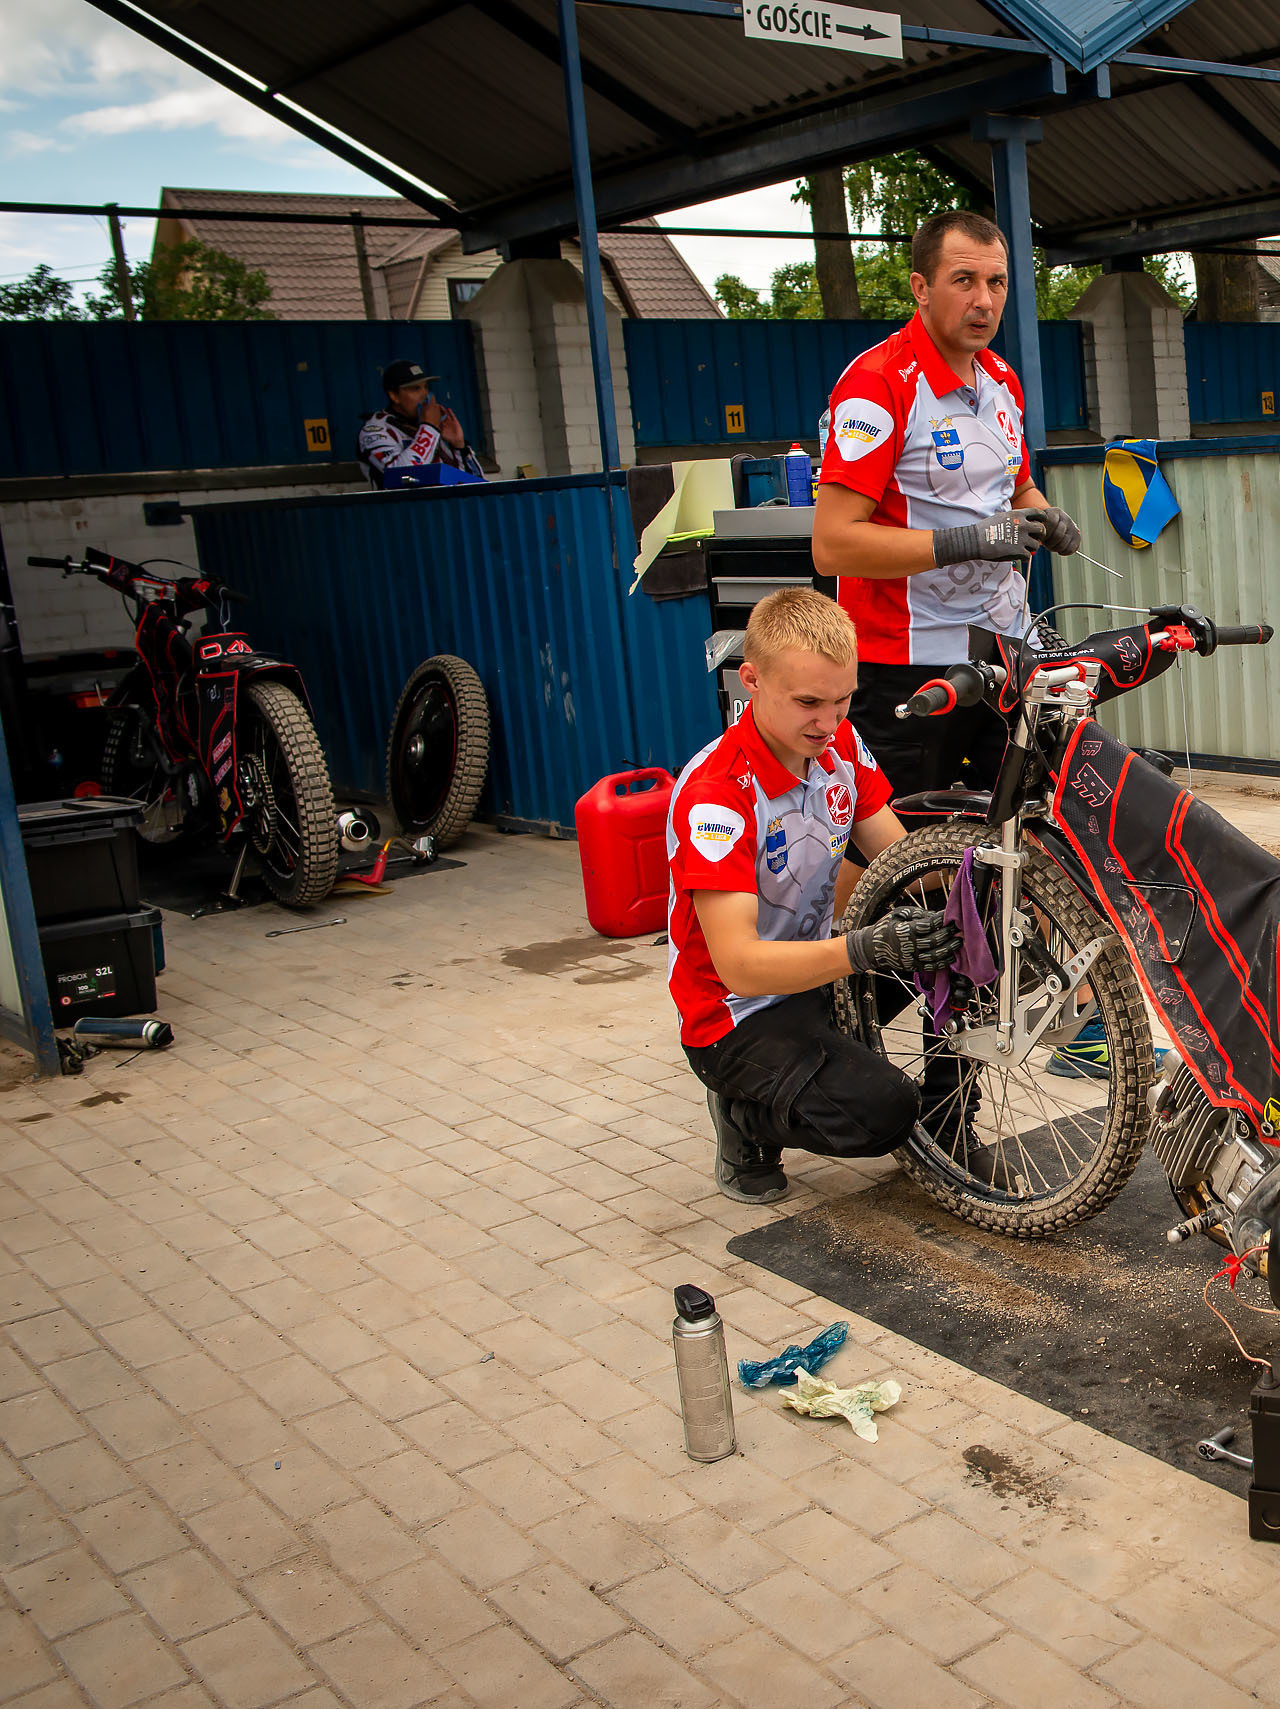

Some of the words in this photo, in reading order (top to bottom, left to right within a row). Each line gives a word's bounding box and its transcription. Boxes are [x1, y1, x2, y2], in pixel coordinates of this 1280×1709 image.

[757, 3, 832, 40] GOŚCIE
[728, 411, 741, 428] 11
[308, 425, 327, 444] 10
[410, 426, 434, 458] BST
[697, 822, 736, 836] eWinner
[57, 973, 88, 984] PROBOX
[95, 966, 113, 977] 32L
